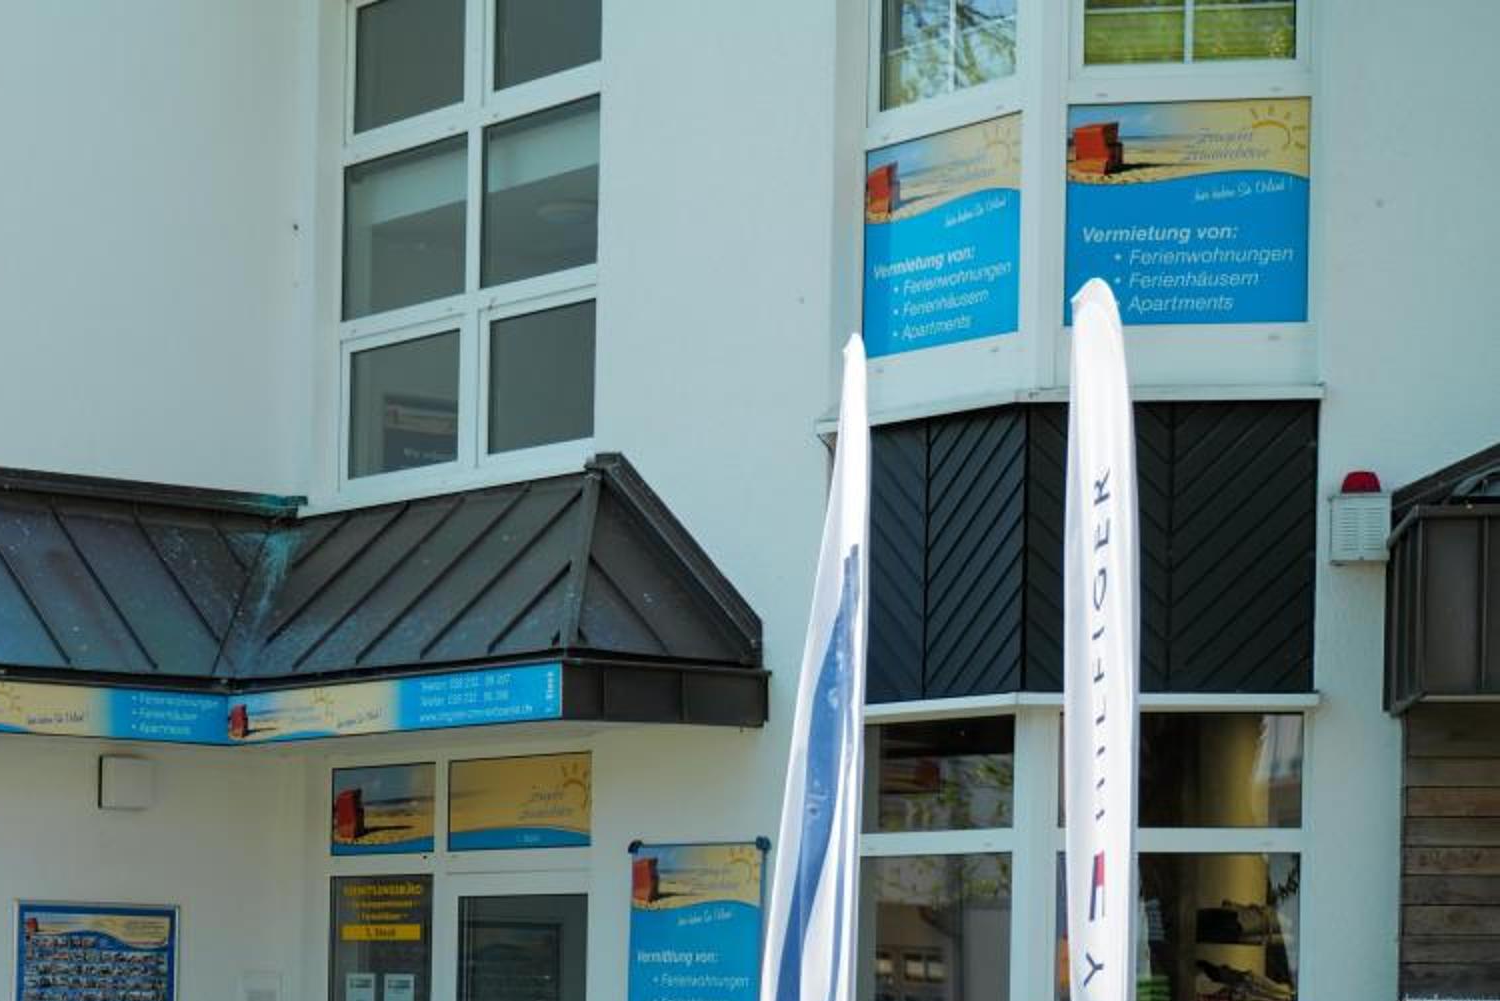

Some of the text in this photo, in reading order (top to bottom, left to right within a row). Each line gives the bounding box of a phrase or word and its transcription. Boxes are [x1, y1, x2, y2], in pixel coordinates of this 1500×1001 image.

[1082, 225, 1239, 245] Vermietung von:
[874, 253, 945, 279] Vermietung
[1129, 247, 1294, 267] Ferienwohnungen
[903, 261, 1012, 297] Ferienwohnungen
[1128, 271, 1260, 289] Ferienhäusern
[1127, 295, 1234, 314] Apartments
[901, 315, 972, 341] Apartments
